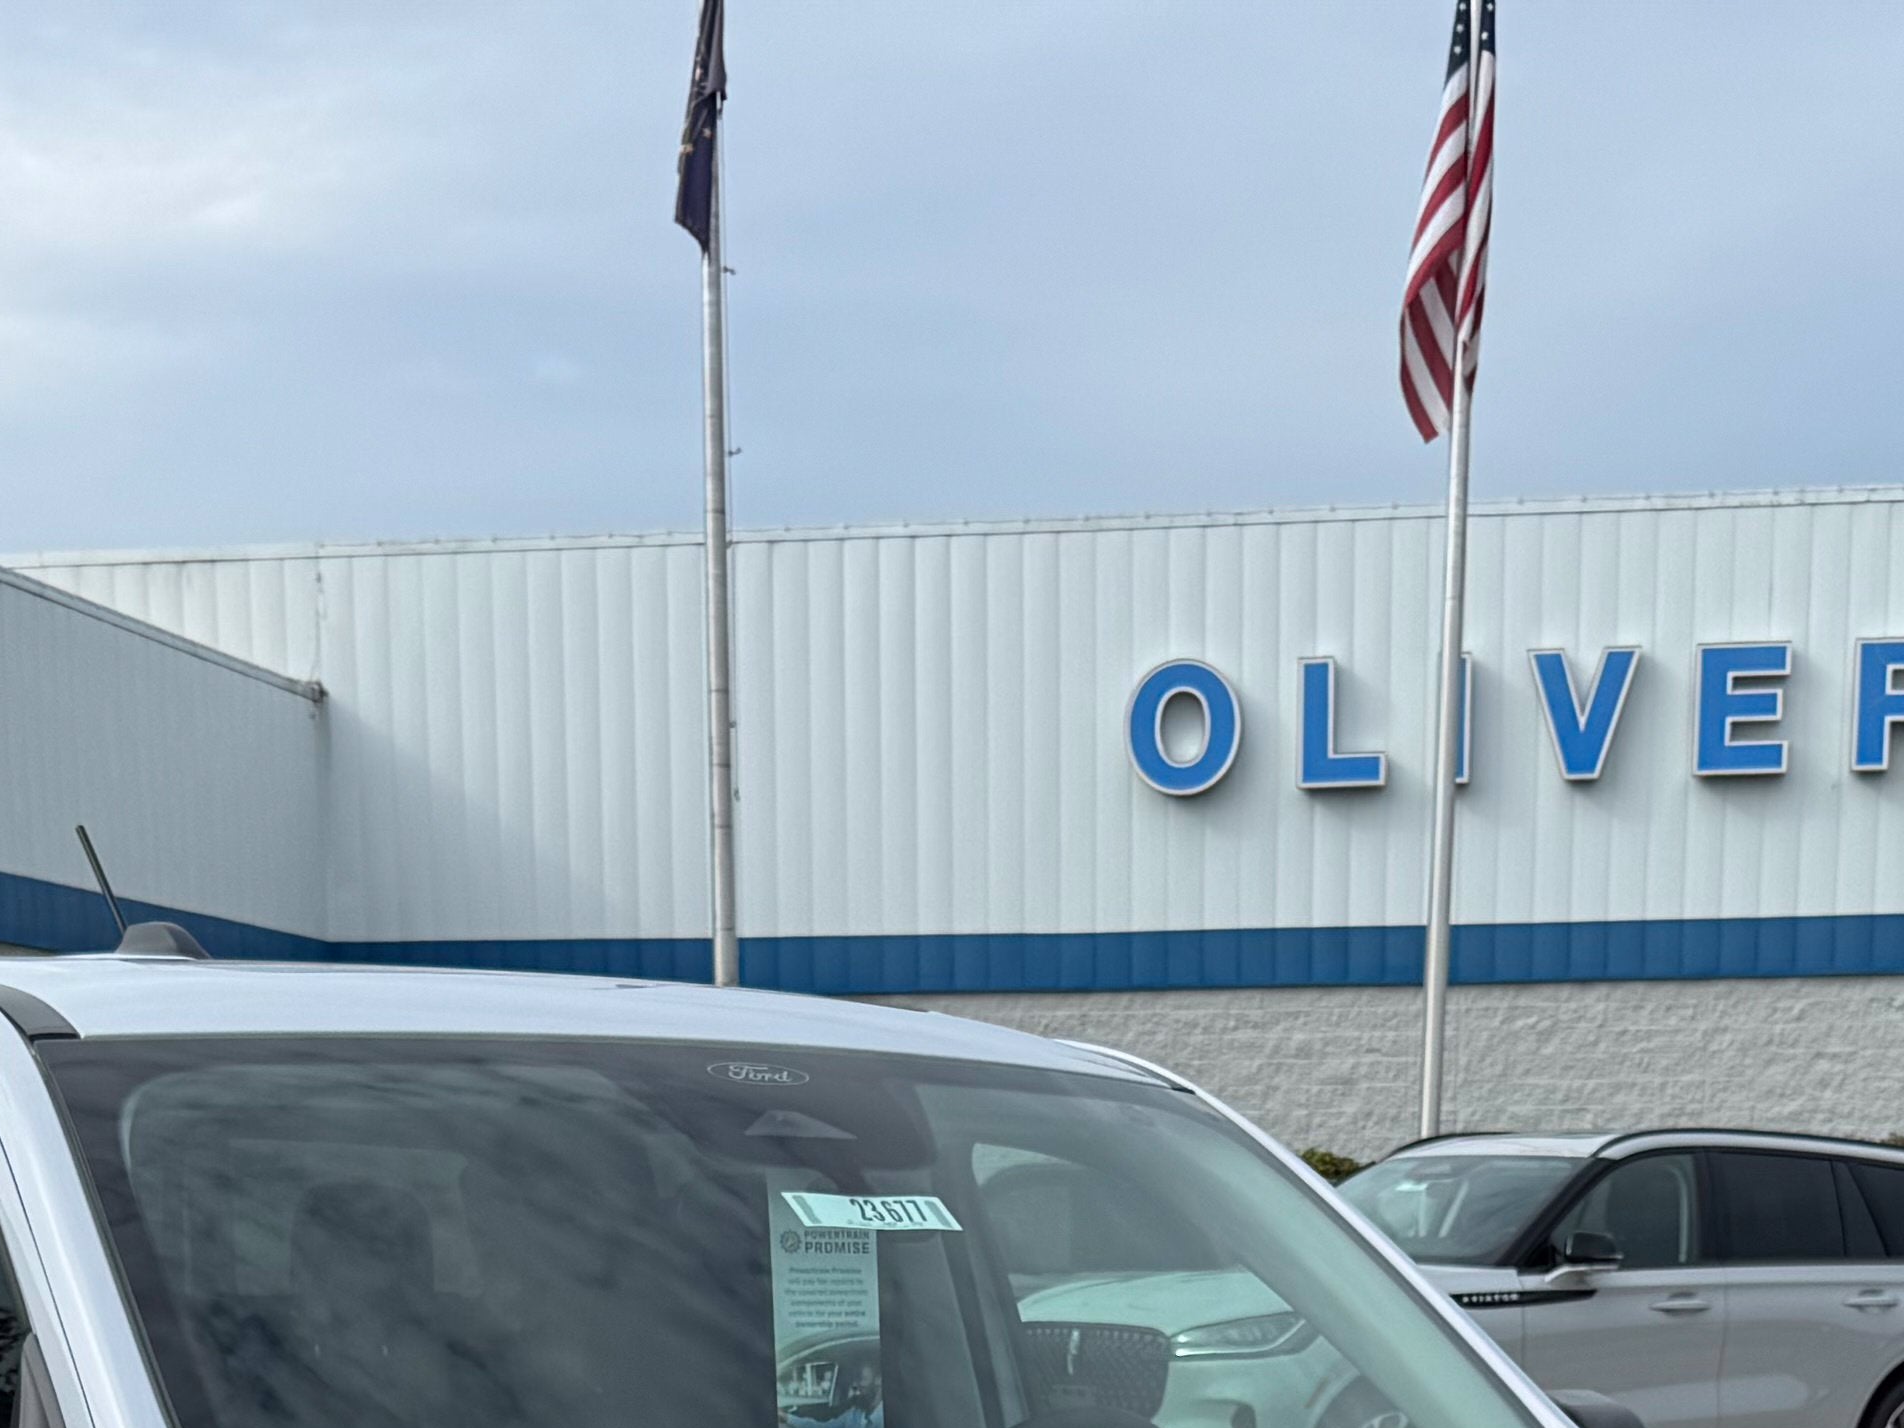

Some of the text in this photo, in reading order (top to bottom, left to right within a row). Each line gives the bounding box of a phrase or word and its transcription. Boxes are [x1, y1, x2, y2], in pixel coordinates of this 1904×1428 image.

[727, 1064, 793, 1082] Ford
[804, 1229, 870, 1240] POWERTRAIN
[804, 1241, 871, 1255] PROMISE
